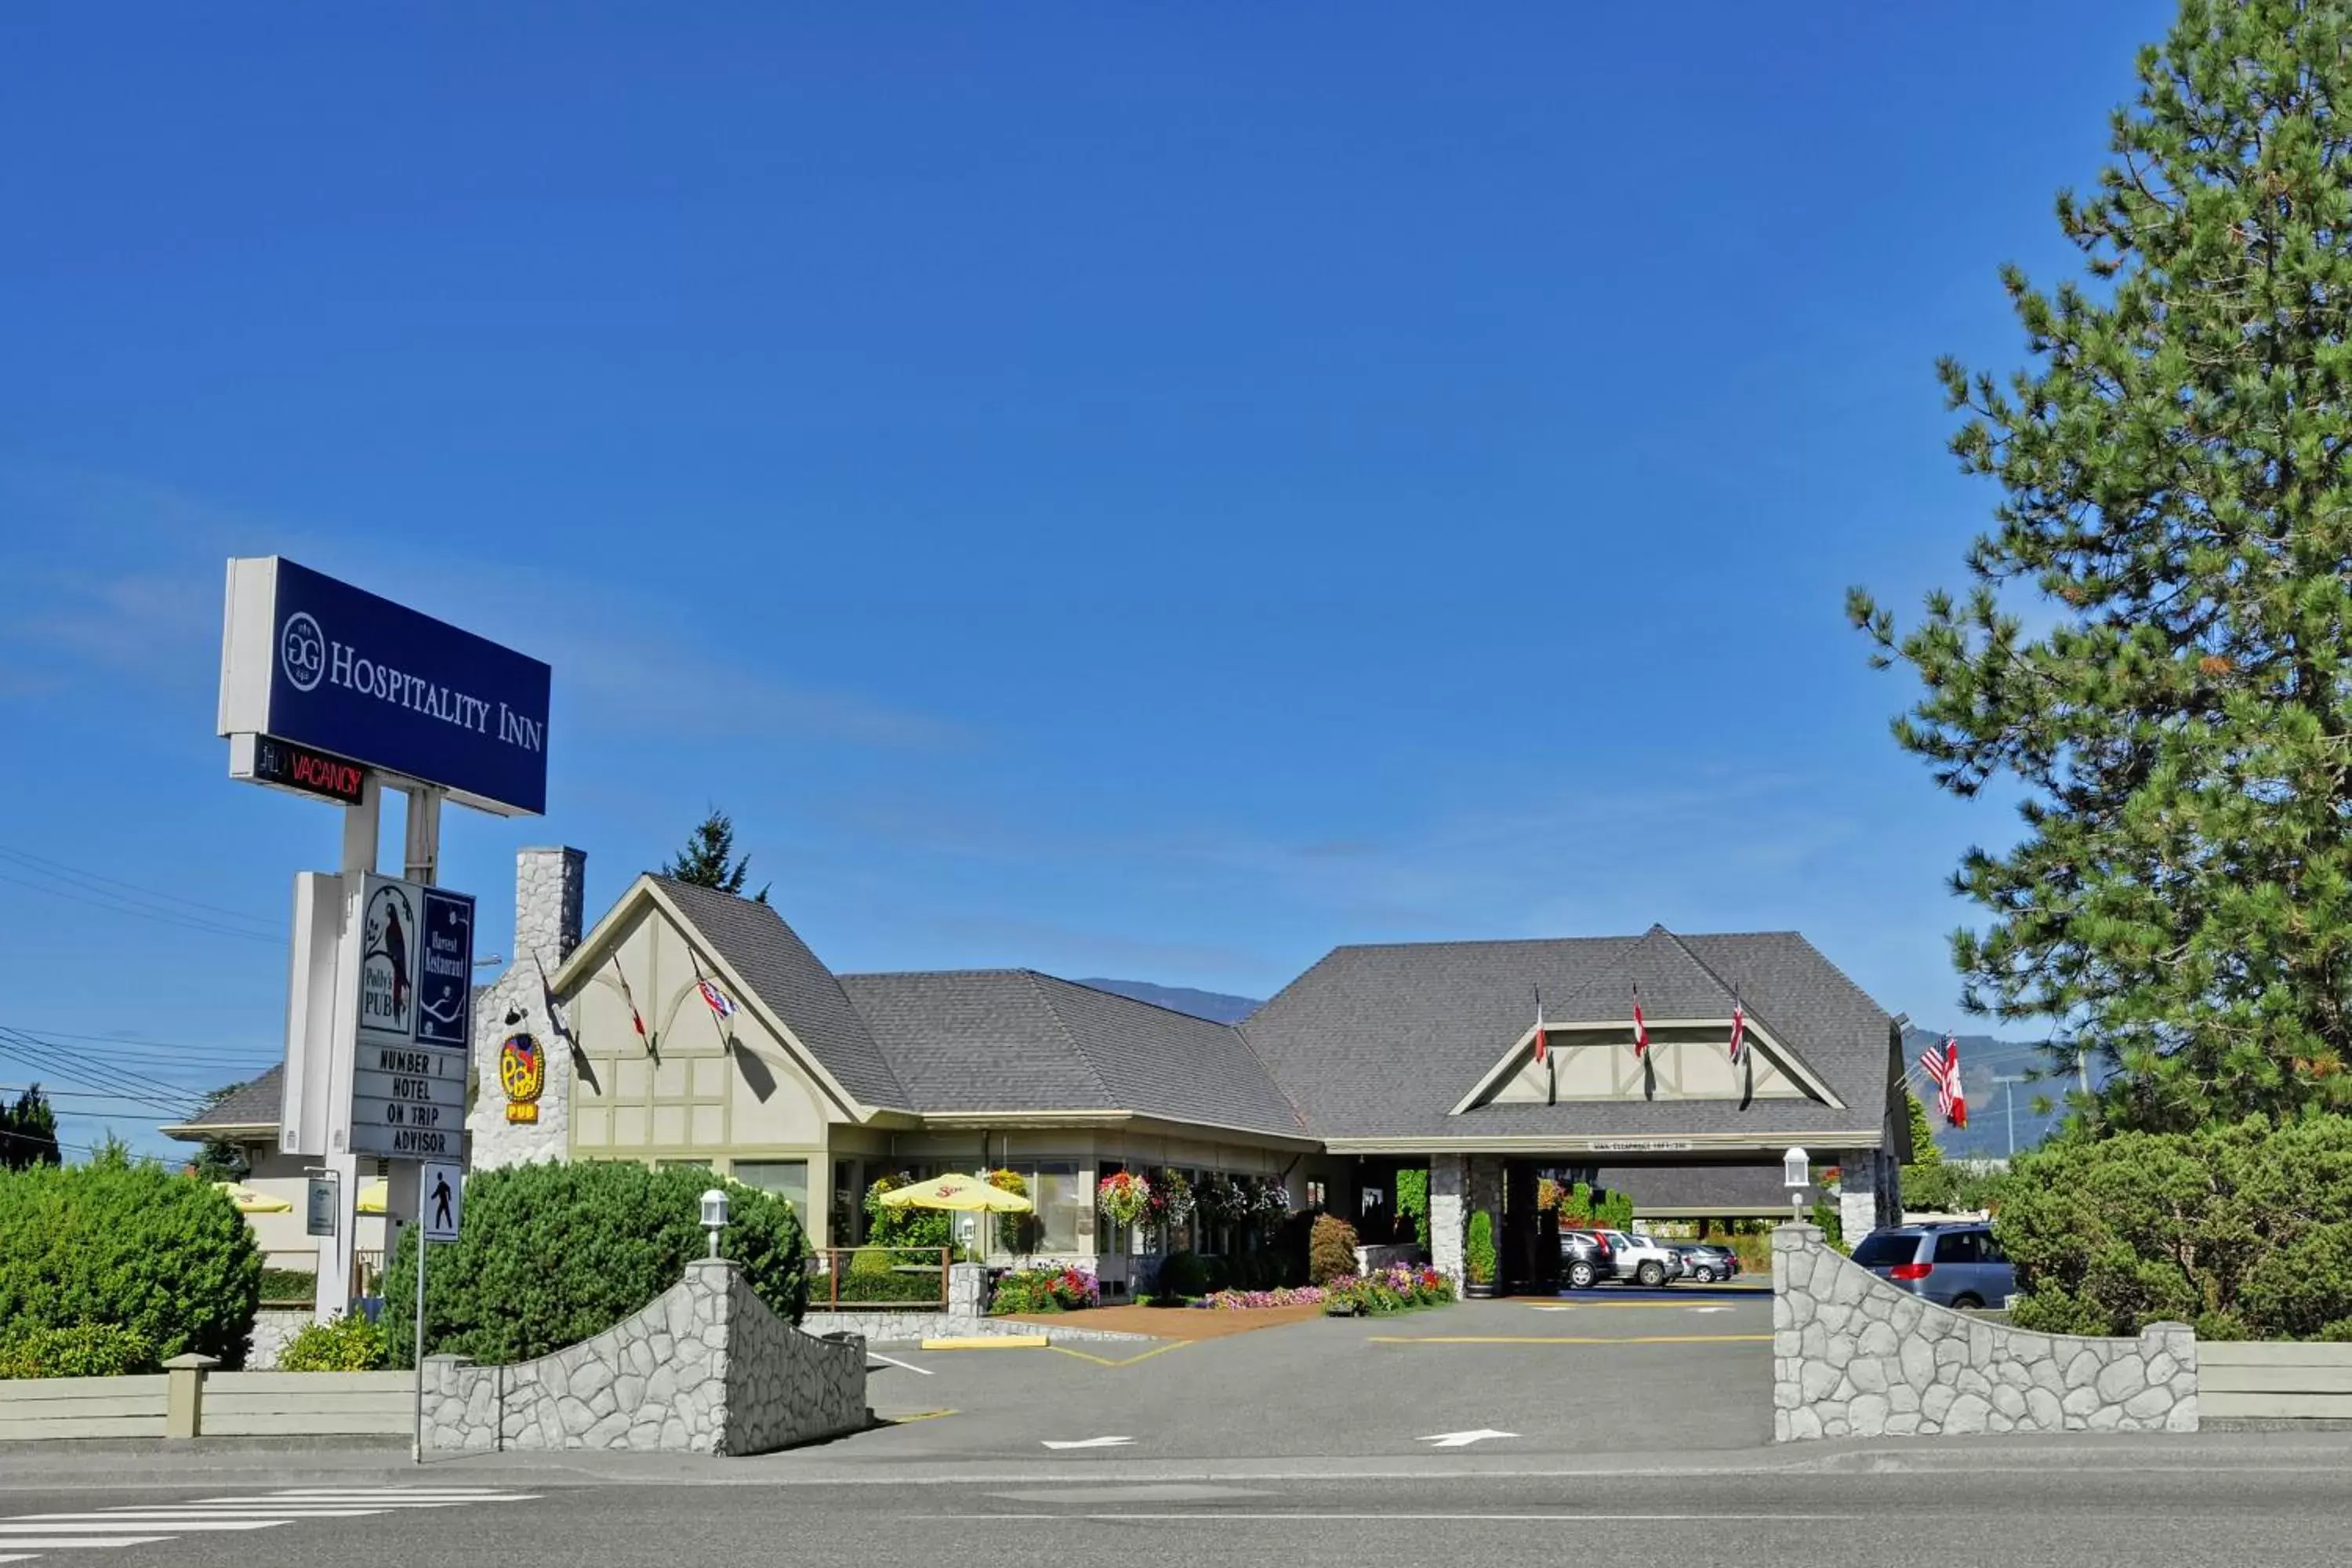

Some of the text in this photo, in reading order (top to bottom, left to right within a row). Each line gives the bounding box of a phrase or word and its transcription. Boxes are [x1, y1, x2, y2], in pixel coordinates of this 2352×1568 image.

[330, 641, 543, 752] HOSPITALITY INN
[292, 753, 364, 794] VACANCY
[425, 947, 463, 978] Restaurant
[366, 967, 392, 993] Polly's
[365, 991, 392, 1016] PUB
[379, 1050, 443, 1075] NUMBER 1
[394, 1078, 430, 1099] HOTEL
[387, 1104, 438, 1126] ON TRIP
[508, 1105, 534, 1119] PUB
[394, 1130, 446, 1152] ADVISOR
